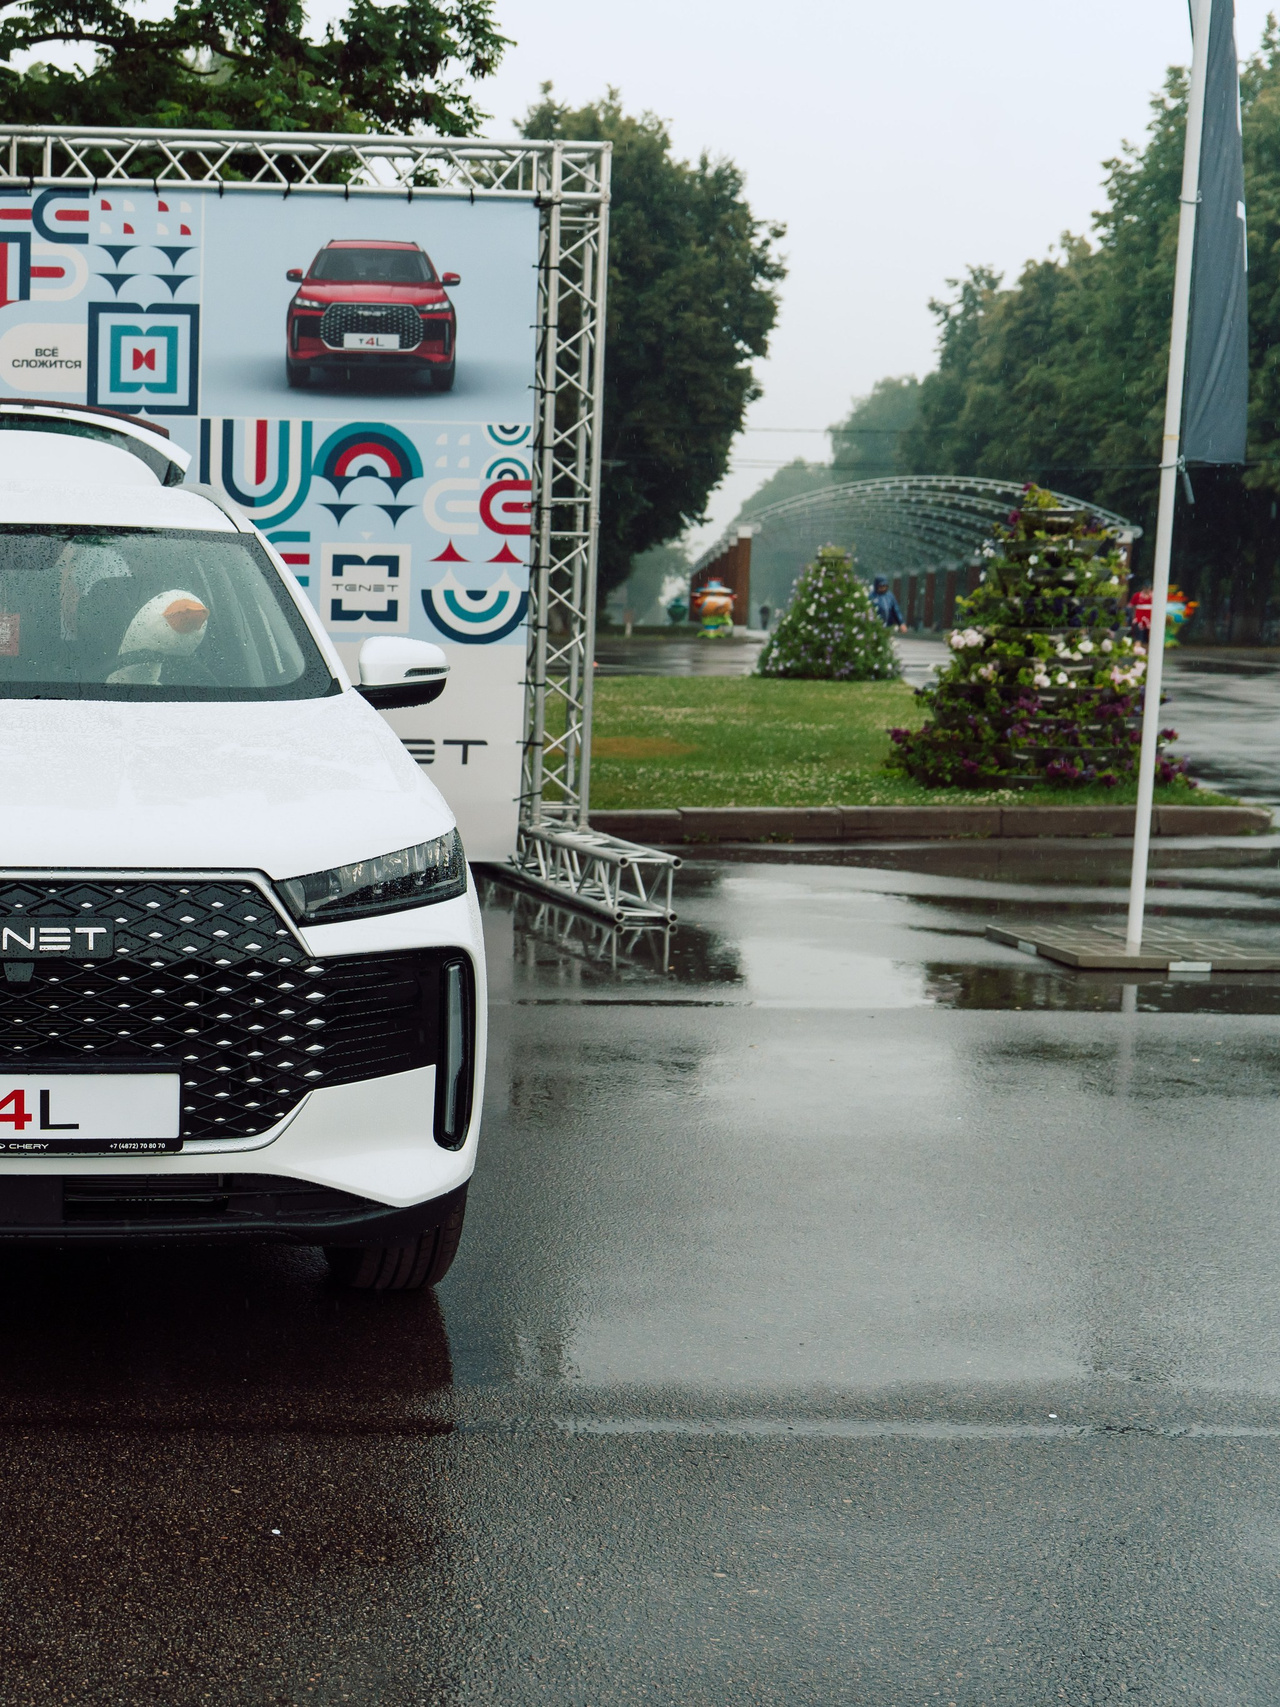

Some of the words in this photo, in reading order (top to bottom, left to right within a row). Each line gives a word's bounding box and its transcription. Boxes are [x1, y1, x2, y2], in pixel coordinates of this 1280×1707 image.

[35, 346, 59, 357] ВСЁ
[11, 359, 82, 369] СЛОЖИТСЯ
[331, 583, 399, 593] TENET
